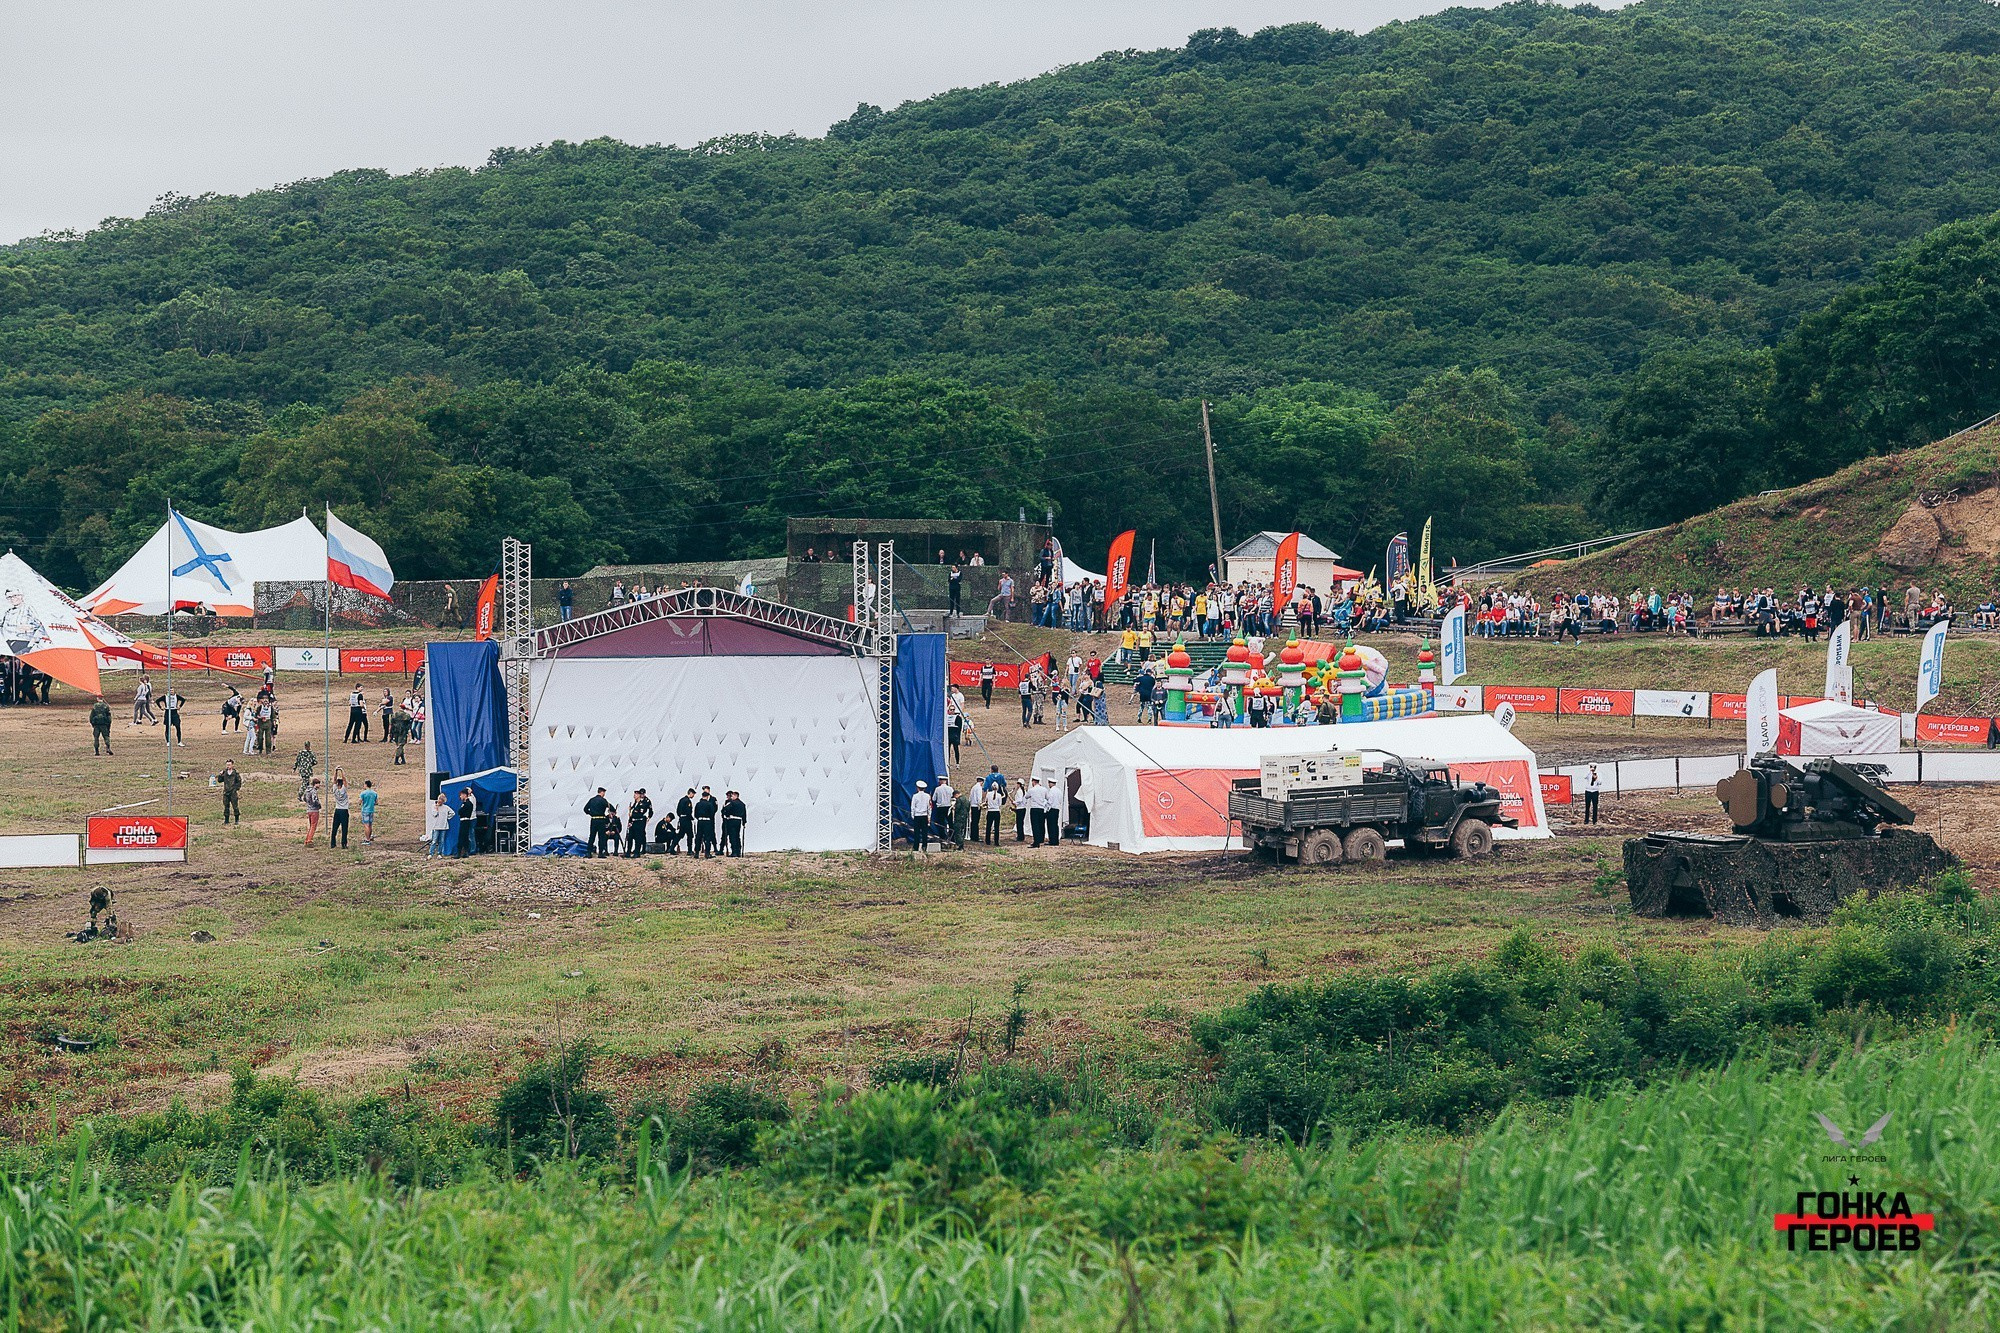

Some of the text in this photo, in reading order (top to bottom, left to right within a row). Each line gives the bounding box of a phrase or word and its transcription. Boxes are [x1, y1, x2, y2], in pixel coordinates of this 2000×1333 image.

[1118, 556, 1126, 589] ГЕРОЕВ
[1495, 694, 1546, 702] ЛИГАГЕРОЕВ.РФ
[1582, 696, 1610, 704] ГОНКА
[1580, 704, 1610, 712] ГЕРОЕВ
[1761, 715, 1770, 747] SLAVDA
[1928, 722, 1980, 732] ЛИГАГЕРОЕВ.РФ
[120, 826, 155, 834] ГОНКА
[116, 836, 158, 844] ГЕРОЕВ
